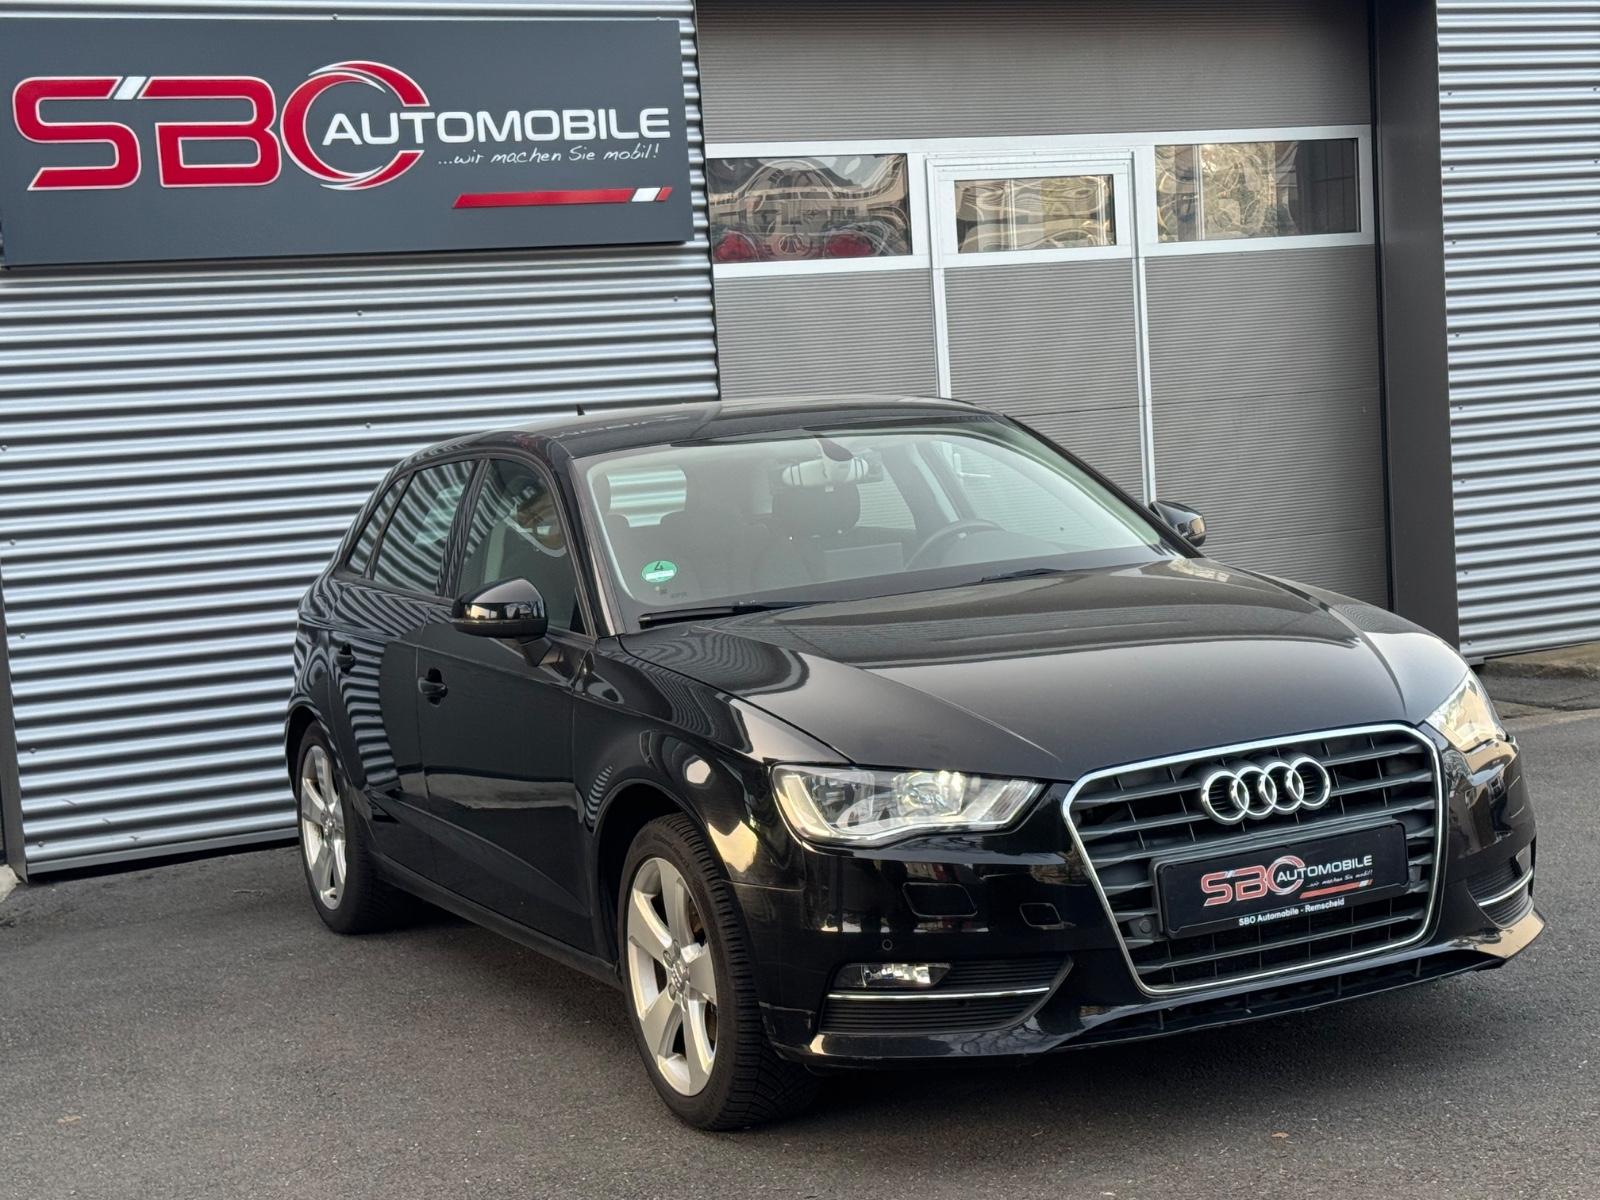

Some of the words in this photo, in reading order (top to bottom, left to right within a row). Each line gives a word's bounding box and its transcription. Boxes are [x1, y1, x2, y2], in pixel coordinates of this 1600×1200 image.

[321, 107, 671, 146] AUTOMOBILE
[491, 147, 562, 164] machen
[569, 145, 595, 161] Sie
[603, 142, 660, 161] mobil!
[1275, 854, 1374, 884] AUTOMOBILE
[1238, 915, 1256, 926] SBO
[1257, 907, 1299, 923] Automobile
[1304, 897, 1345, 913] Remscheid
